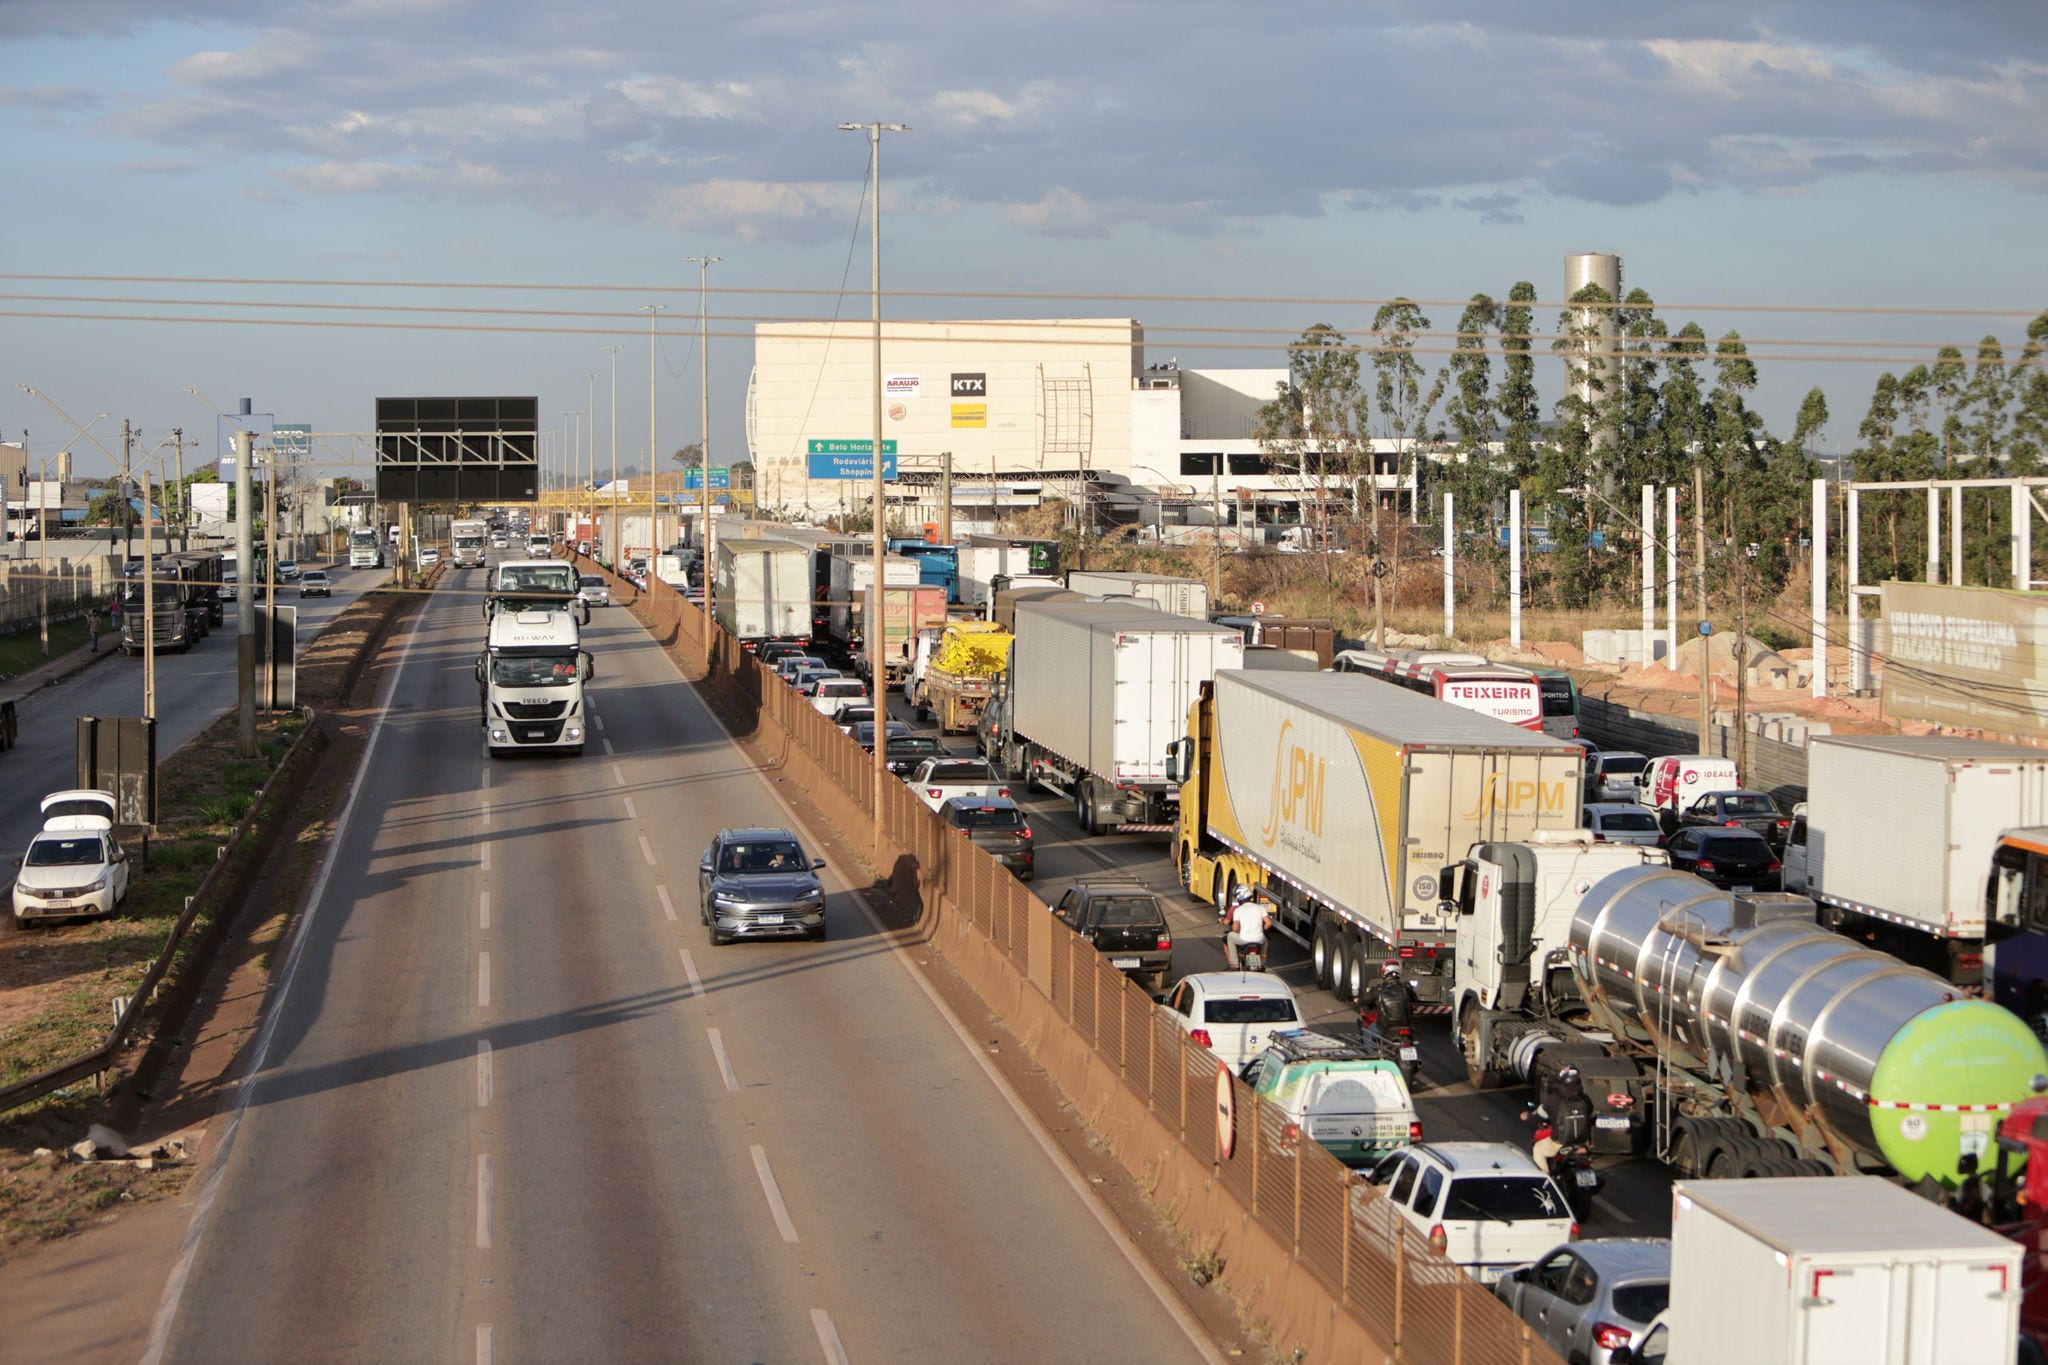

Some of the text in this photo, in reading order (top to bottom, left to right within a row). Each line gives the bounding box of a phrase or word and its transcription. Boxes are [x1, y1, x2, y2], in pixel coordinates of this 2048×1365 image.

[953, 379, 983, 391] KTX
[840, 468, 874, 476] Shoppin
[1451, 686, 1531, 699] TEIXEIRA
[1492, 708, 1533, 716] TURISMO
[1281, 744, 1326, 838] JPM
[1495, 781, 1565, 811] JPM
[1419, 882, 1431, 890] ISO
